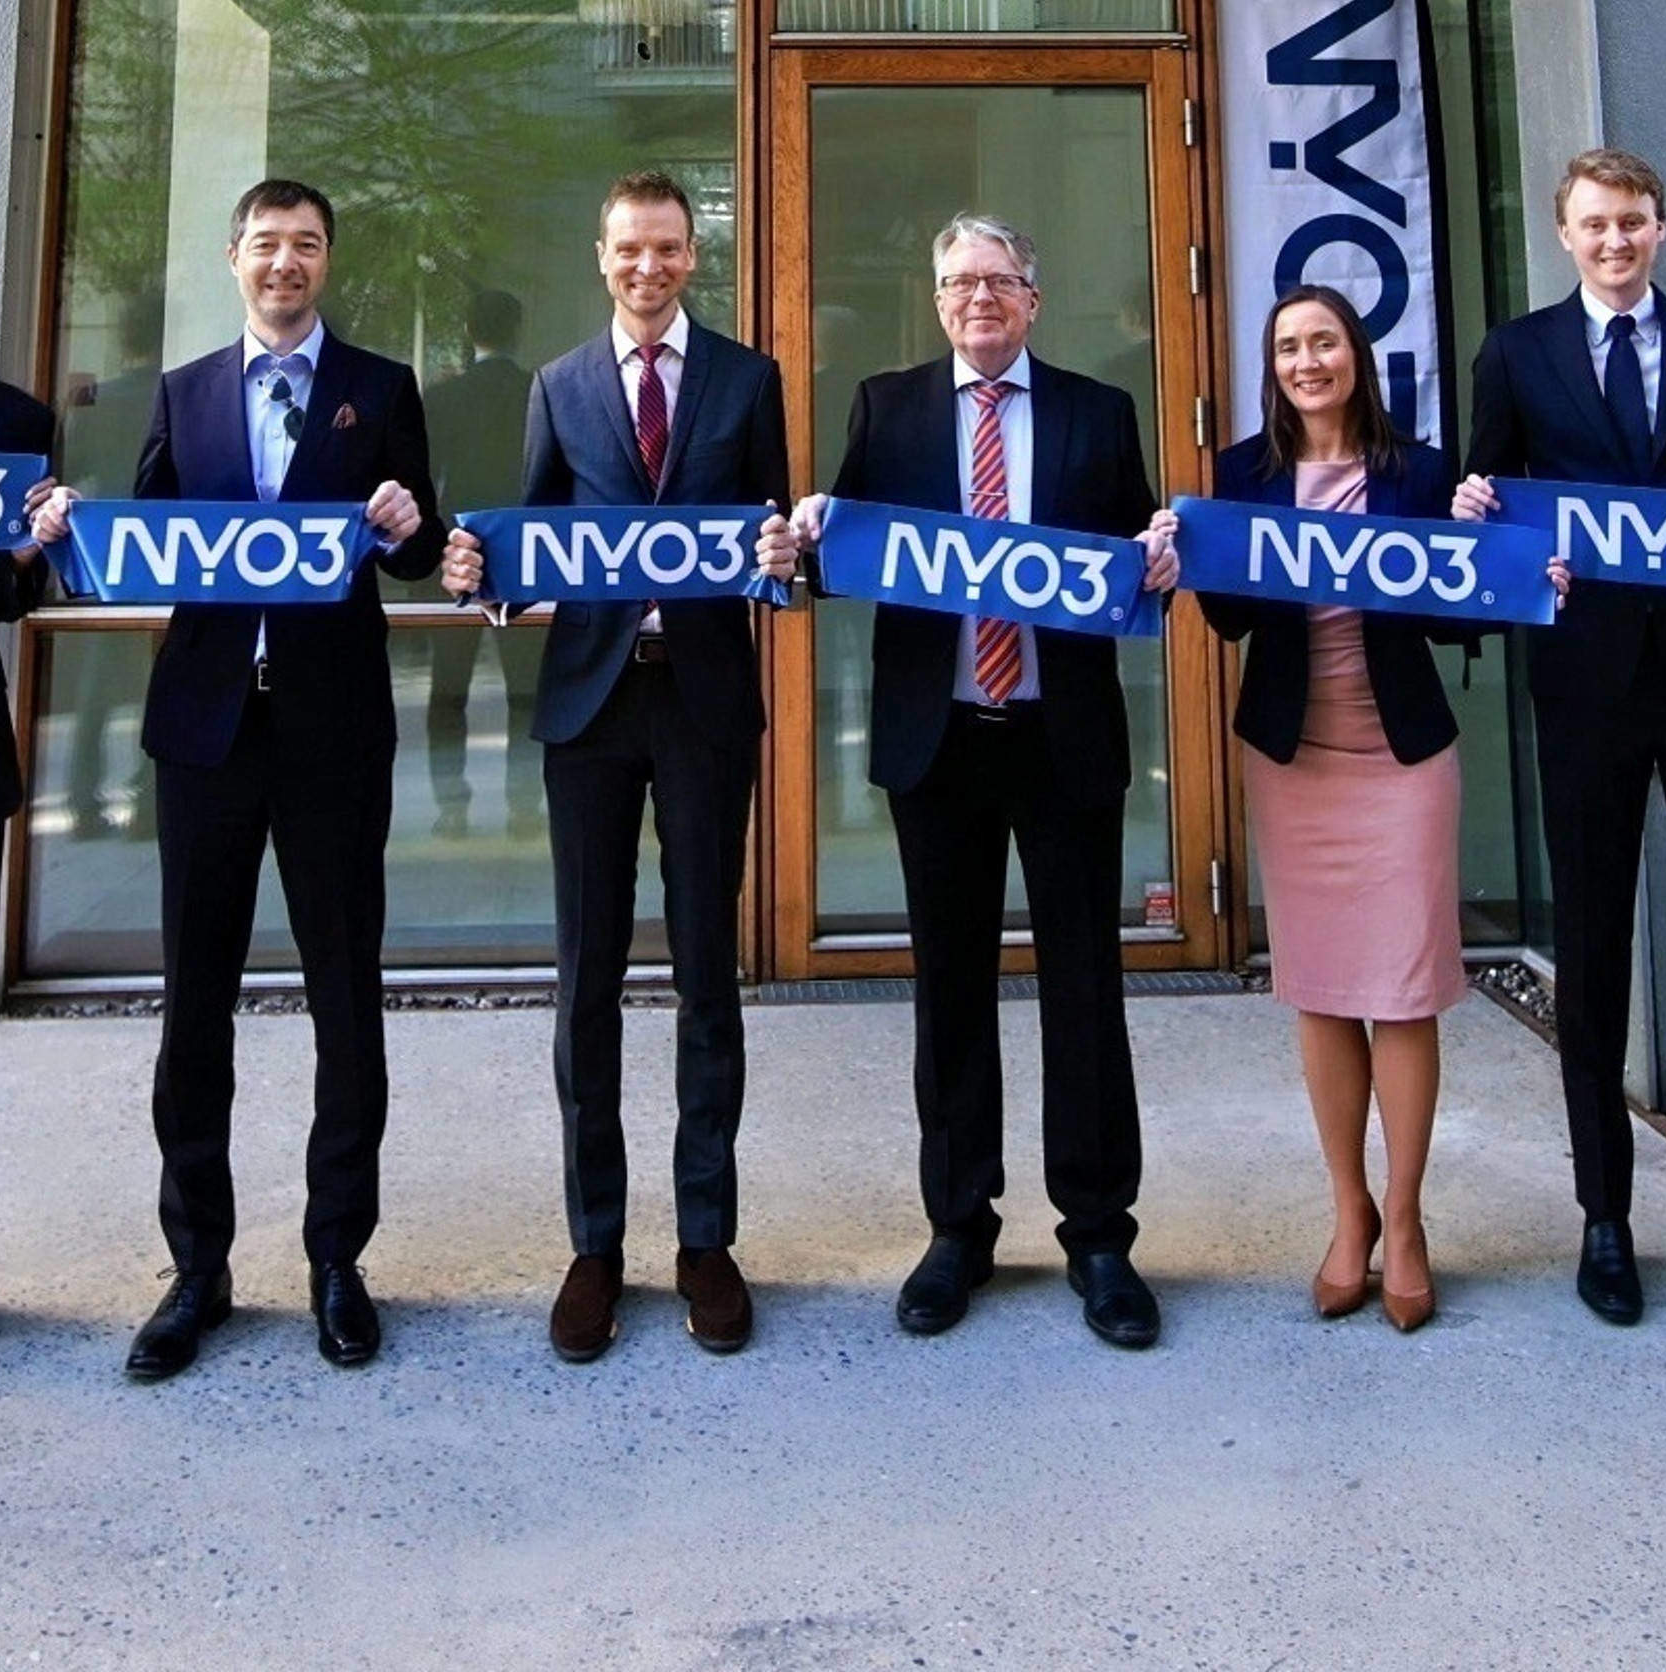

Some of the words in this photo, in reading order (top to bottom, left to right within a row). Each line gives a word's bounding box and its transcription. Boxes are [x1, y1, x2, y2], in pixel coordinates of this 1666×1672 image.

[106, 518, 349, 586] NYO3
[521, 520, 745, 585] NYO3
[882, 521, 1113, 615] NYO3
[1250, 518, 1478, 601] NYO3
